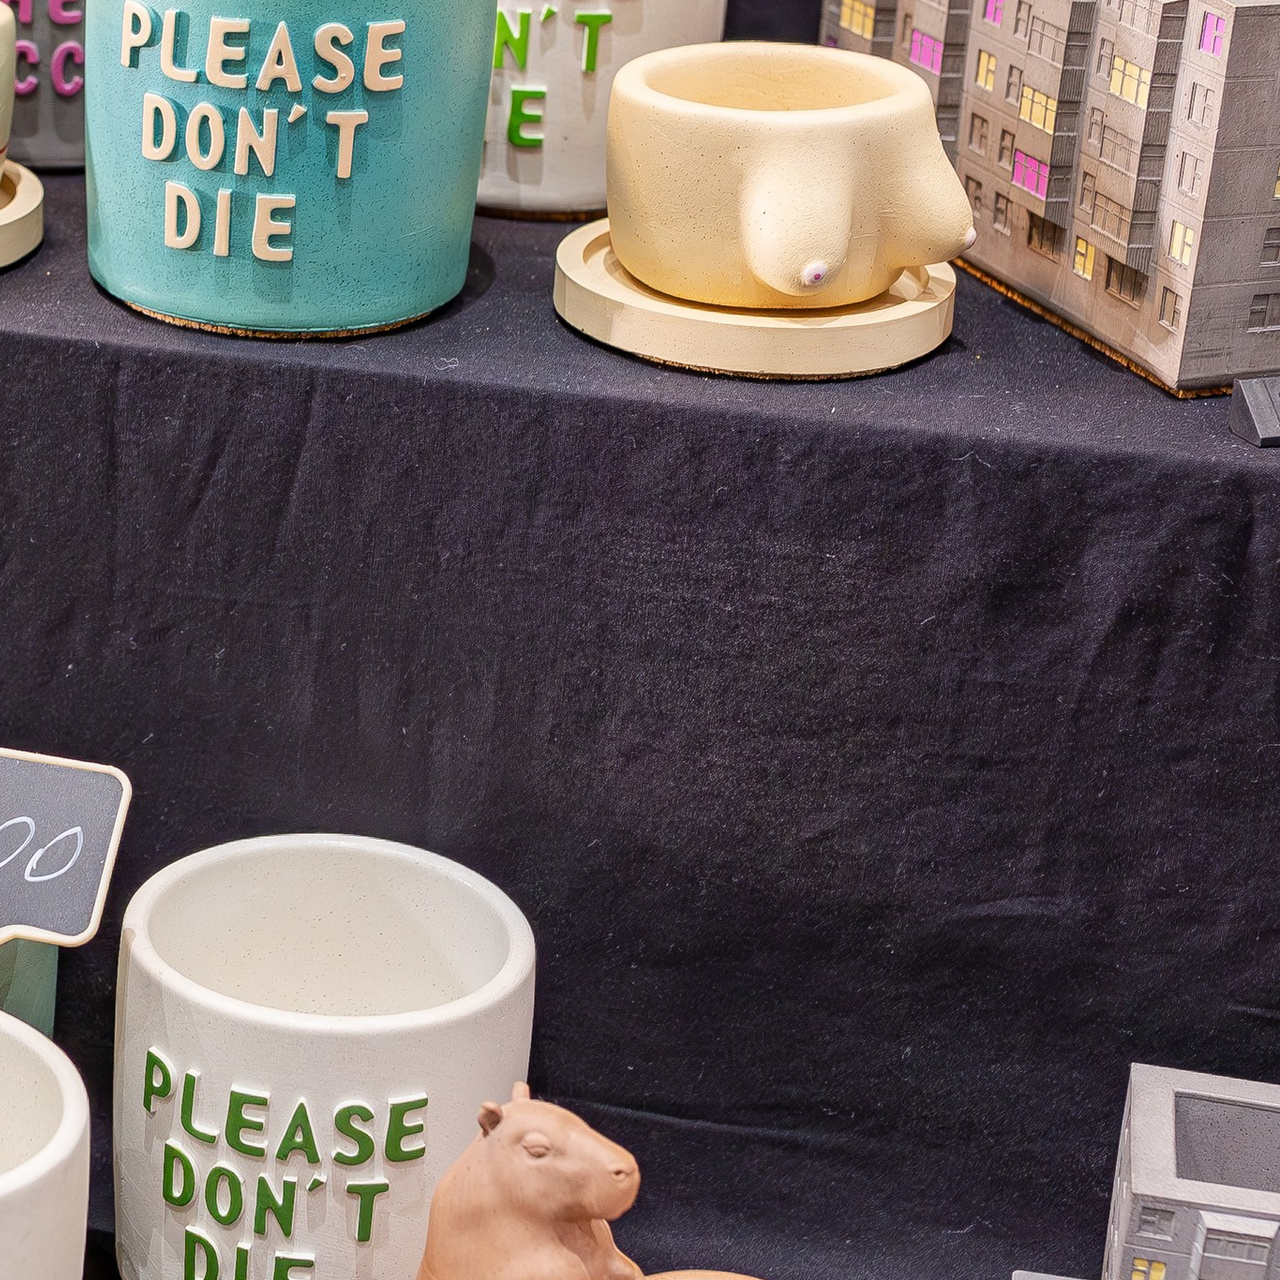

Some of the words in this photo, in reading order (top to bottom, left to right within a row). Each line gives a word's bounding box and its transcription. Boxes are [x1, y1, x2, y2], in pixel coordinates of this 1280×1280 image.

[141, 91, 369, 179] DON'T
[164, 181, 296, 262] DIE
[143, 1046, 428, 1166] PLEASE
[162, 1138, 389, 1243] DON'T
